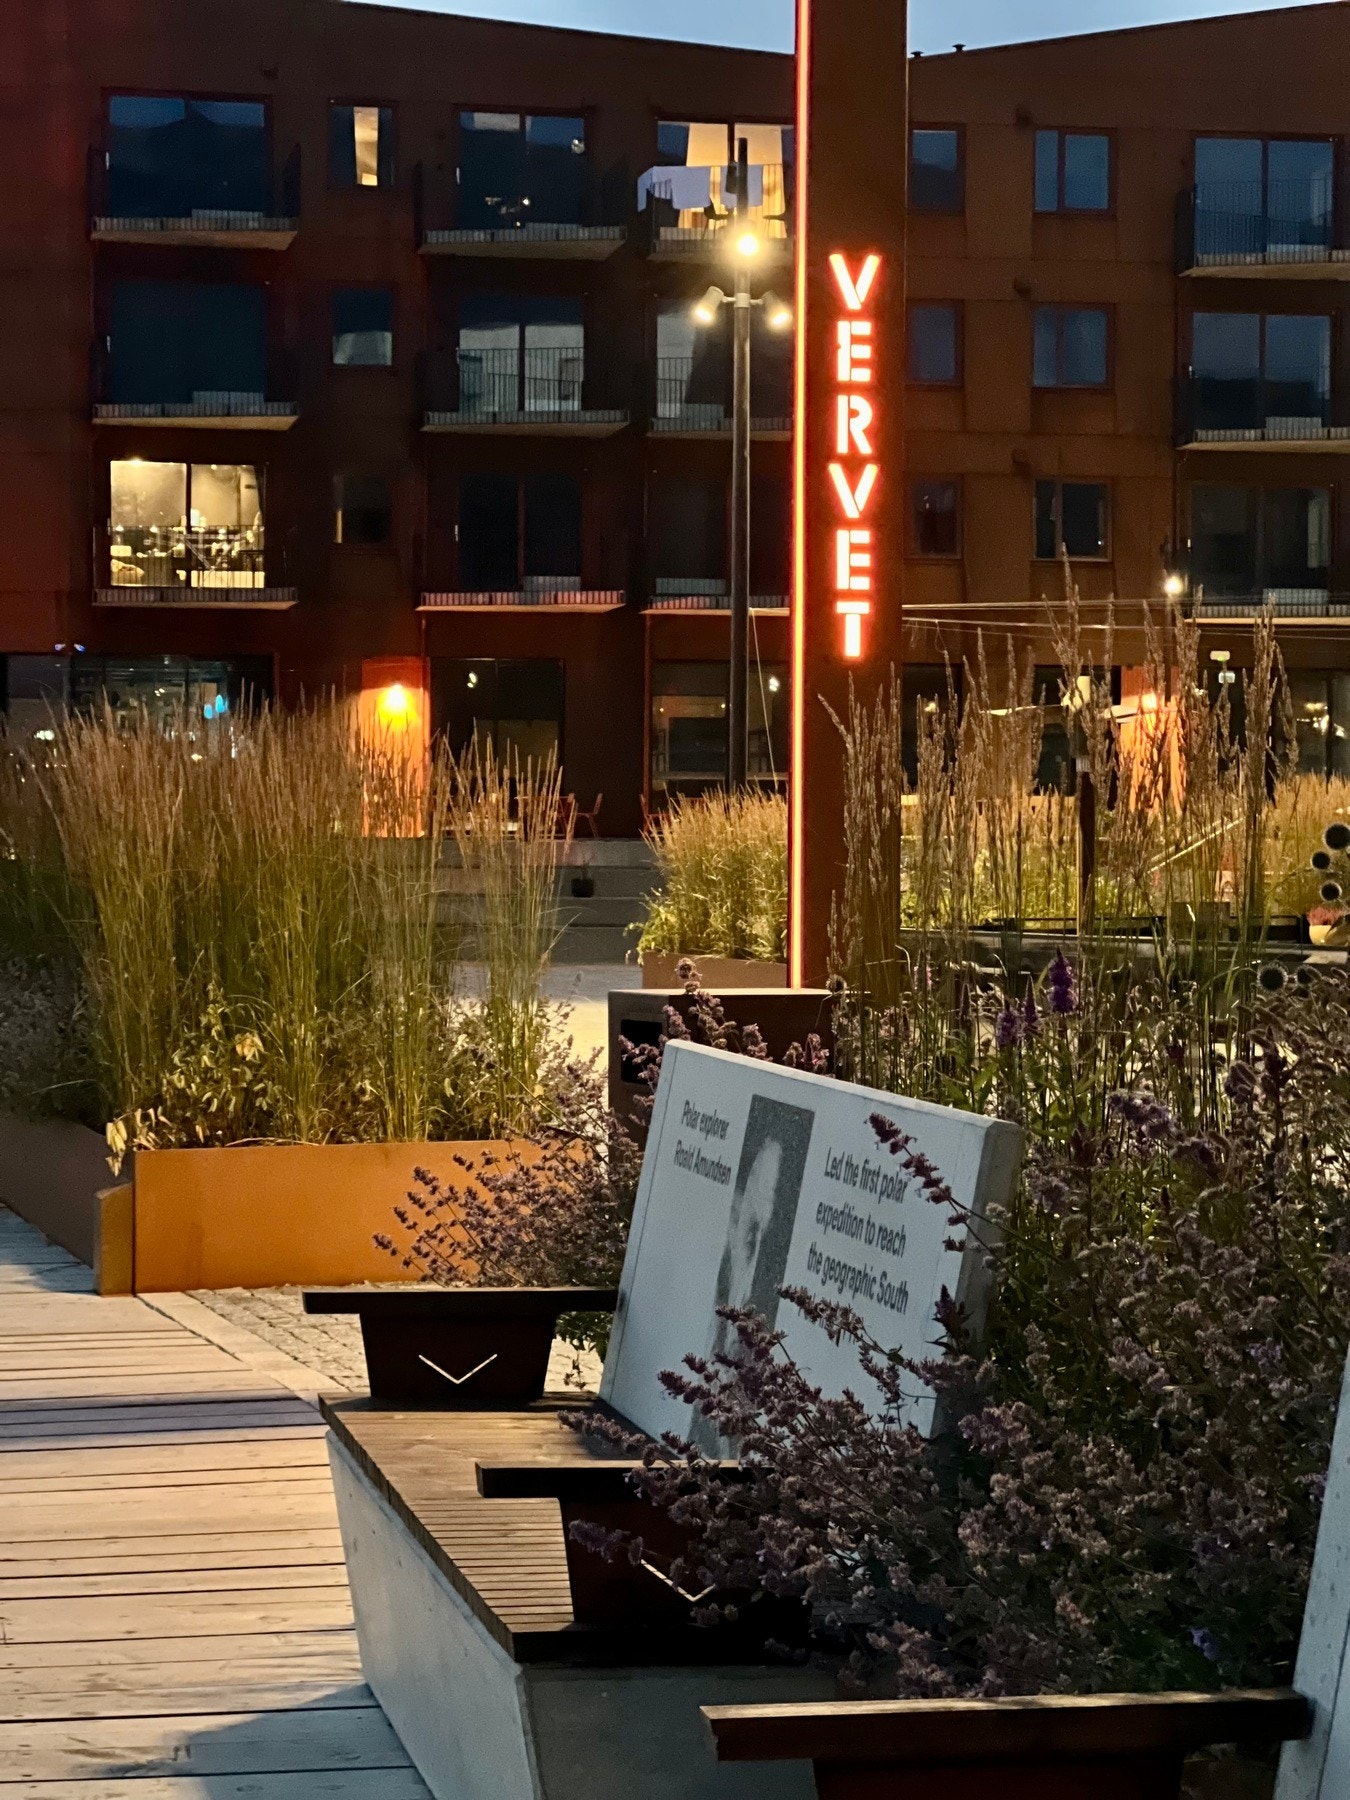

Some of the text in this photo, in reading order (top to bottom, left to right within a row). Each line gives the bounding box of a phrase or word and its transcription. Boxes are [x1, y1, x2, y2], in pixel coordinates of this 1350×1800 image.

[828, 253, 881, 658] VERVET
[681, 1099, 730, 1141] Polar explorer
[673, 1139, 732, 1187] Roald Amundsen
[824, 1146, 908, 1205] Led the first polar
[816, 1201, 907, 1258] expedition to reach
[807, 1241, 909, 1315] the geographic South
